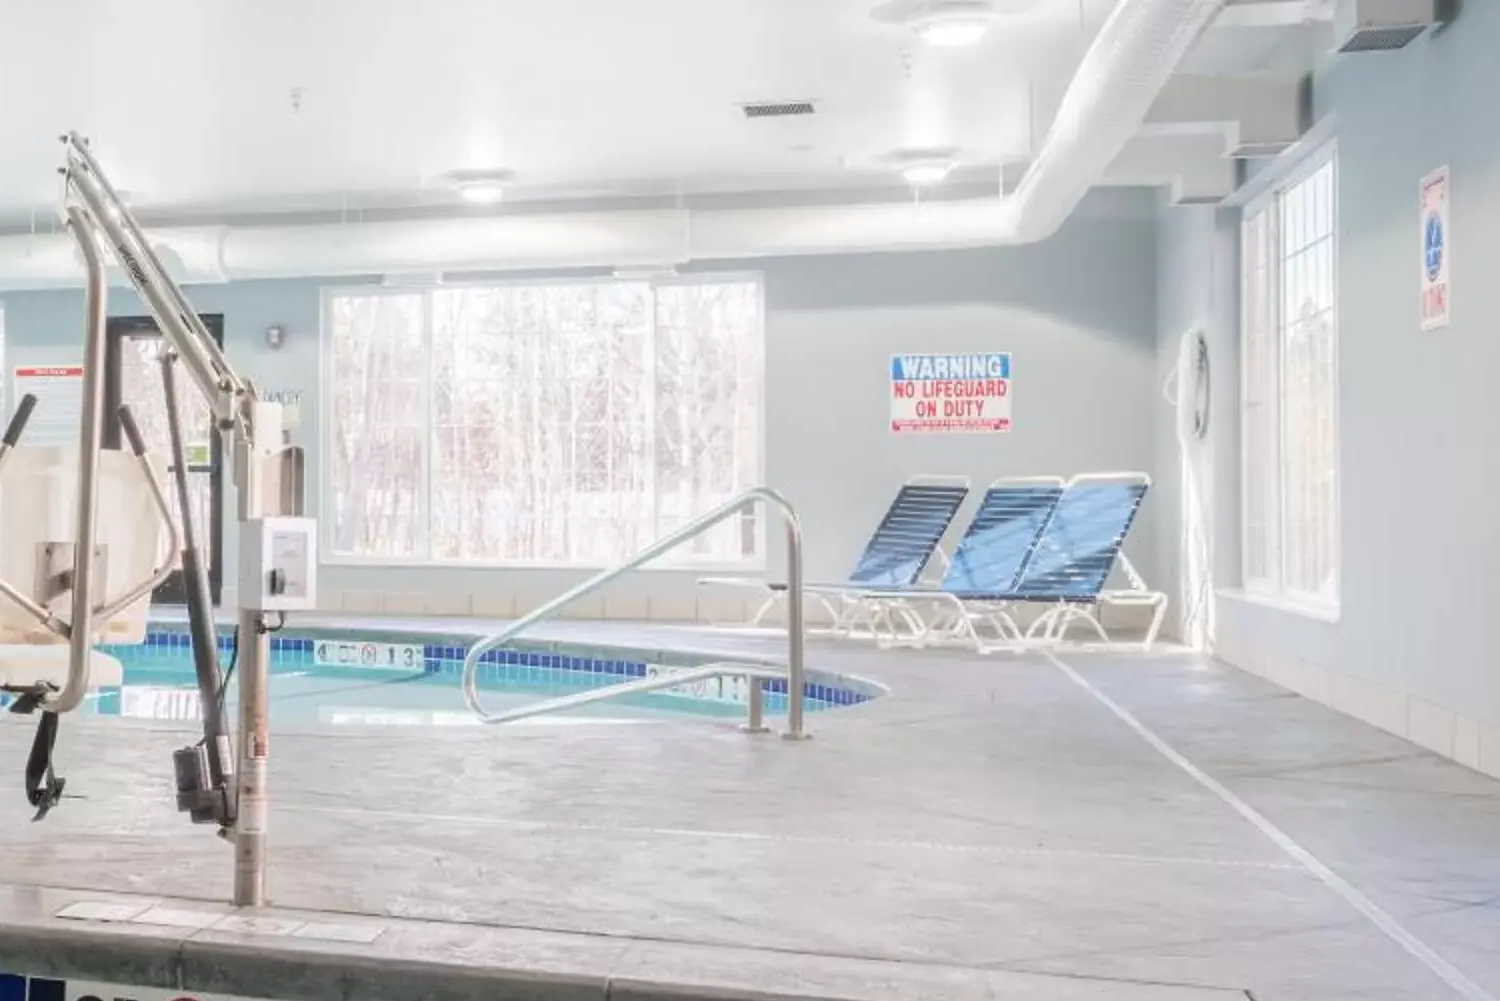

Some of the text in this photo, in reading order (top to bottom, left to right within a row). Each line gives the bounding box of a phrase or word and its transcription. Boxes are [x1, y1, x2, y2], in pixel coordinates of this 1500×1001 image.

[901, 355, 1001, 379] WARNING
[894, 380, 1007, 398] NO LIFEGUARD
[915, 400, 985, 417] ON DUTY
